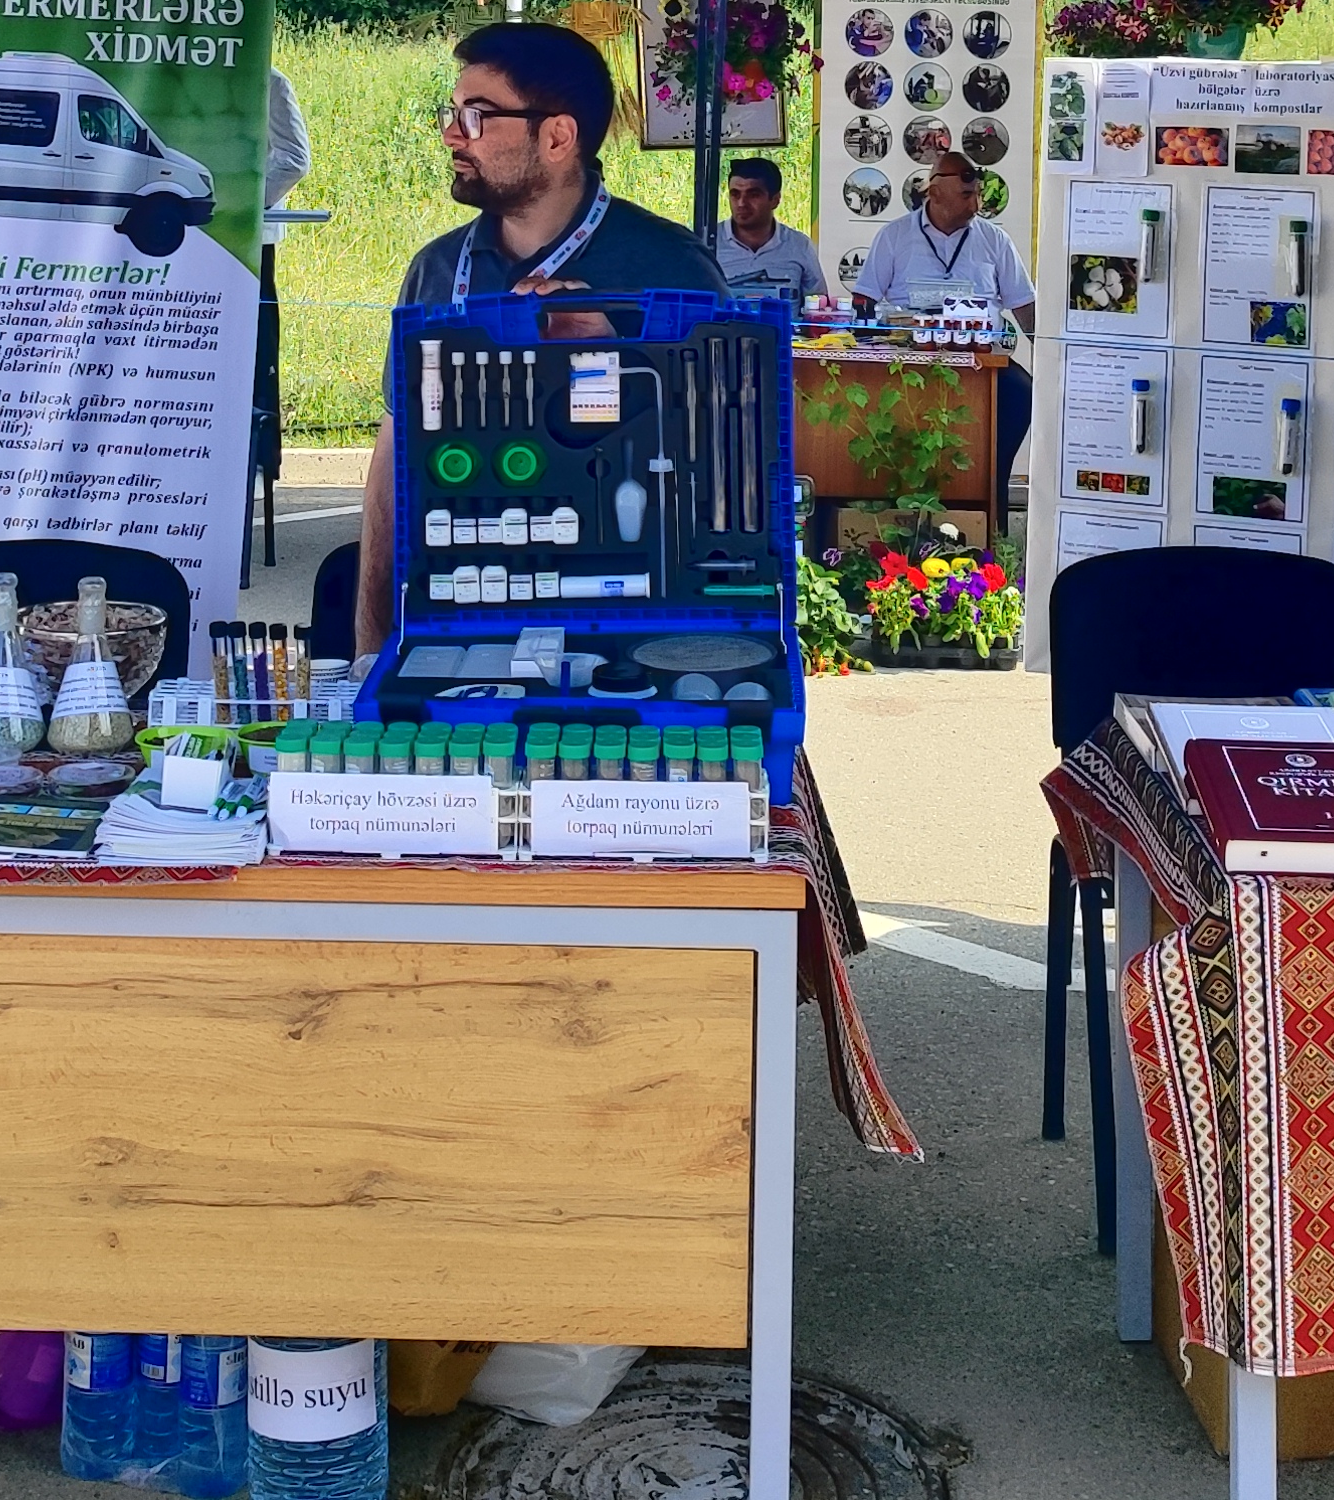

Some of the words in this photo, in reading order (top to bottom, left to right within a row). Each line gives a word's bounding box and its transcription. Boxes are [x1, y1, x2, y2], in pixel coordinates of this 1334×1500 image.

[84, 26, 244, 68] XİDMƏT
[1198, 83, 1247, 98] bölgələr
[1254, 86, 1280, 97] üzrə
[1176, 98, 1245, 114] hazırlanmış
[1253, 102, 1323, 116] kompostlar
[14, 256, 171, 286] Fermerlər!
[15, 285, 84, 301] artırmaq,
[89, 289, 127, 300] onun
[132, 289, 222, 307] münbitliyini
[48, 300, 76, 313] əldə
[80, 303, 127, 316] etmək
[129, 304, 164, 319] üçün
[167, 305, 222, 320] müasir
[55, 315, 83, 328] əkin
[86, 319, 159, 332] sahəsində
[163, 321, 219, 337] birbaşa
[3, 344, 81, 360] göstəririk!
[13, 332, 96, 347] aparmaqla
[104, 335, 136, 347] vaxt
[143, 335, 218, 351] itirmədən
[68, 363, 114, 379] (NPK)
[122, 367, 138, 377] və
[145, 365, 217, 381] humusun
[19, 390, 72, 406] biləcək
[79, 394, 125, 410] gübrə
[133, 399, 214, 412] normasını
[48, 407, 146, 424] çirklənmədən
[150, 415, 213, 430] qoruyur,
[71, 442, 89, 453] və
[97, 442, 212, 459] qranulometrik
[17, 468, 49, 484] (pH)
[50, 471, 115, 487] müəyyən
[117, 473, 162, 490] edilir;
[17, 485, 121, 503] şorakətləşmə
[128, 491, 208, 506] prosesləri
[3, 516, 39, 531] qarşı
[47, 516, 113, 532] tədbirlər
[119, 520, 159, 536] planı
[167, 523, 208, 540] təklif
[290, 789, 370, 810] Həkəriçay
[376, 791, 437, 809] hövzəsi
[442, 793, 477, 809] üzrə
[561, 791, 620, 811] Ağdam
[625, 797, 680, 813] rayonu
[685, 796, 720, 810] üzrə
[310, 816, 361, 835] torpaq
[365, 815, 456, 834] nümunələri
[567, 818, 618, 837] torpaq
[622, 819, 713, 837] nümunələri
[304, 1377, 368, 1413] suyu
